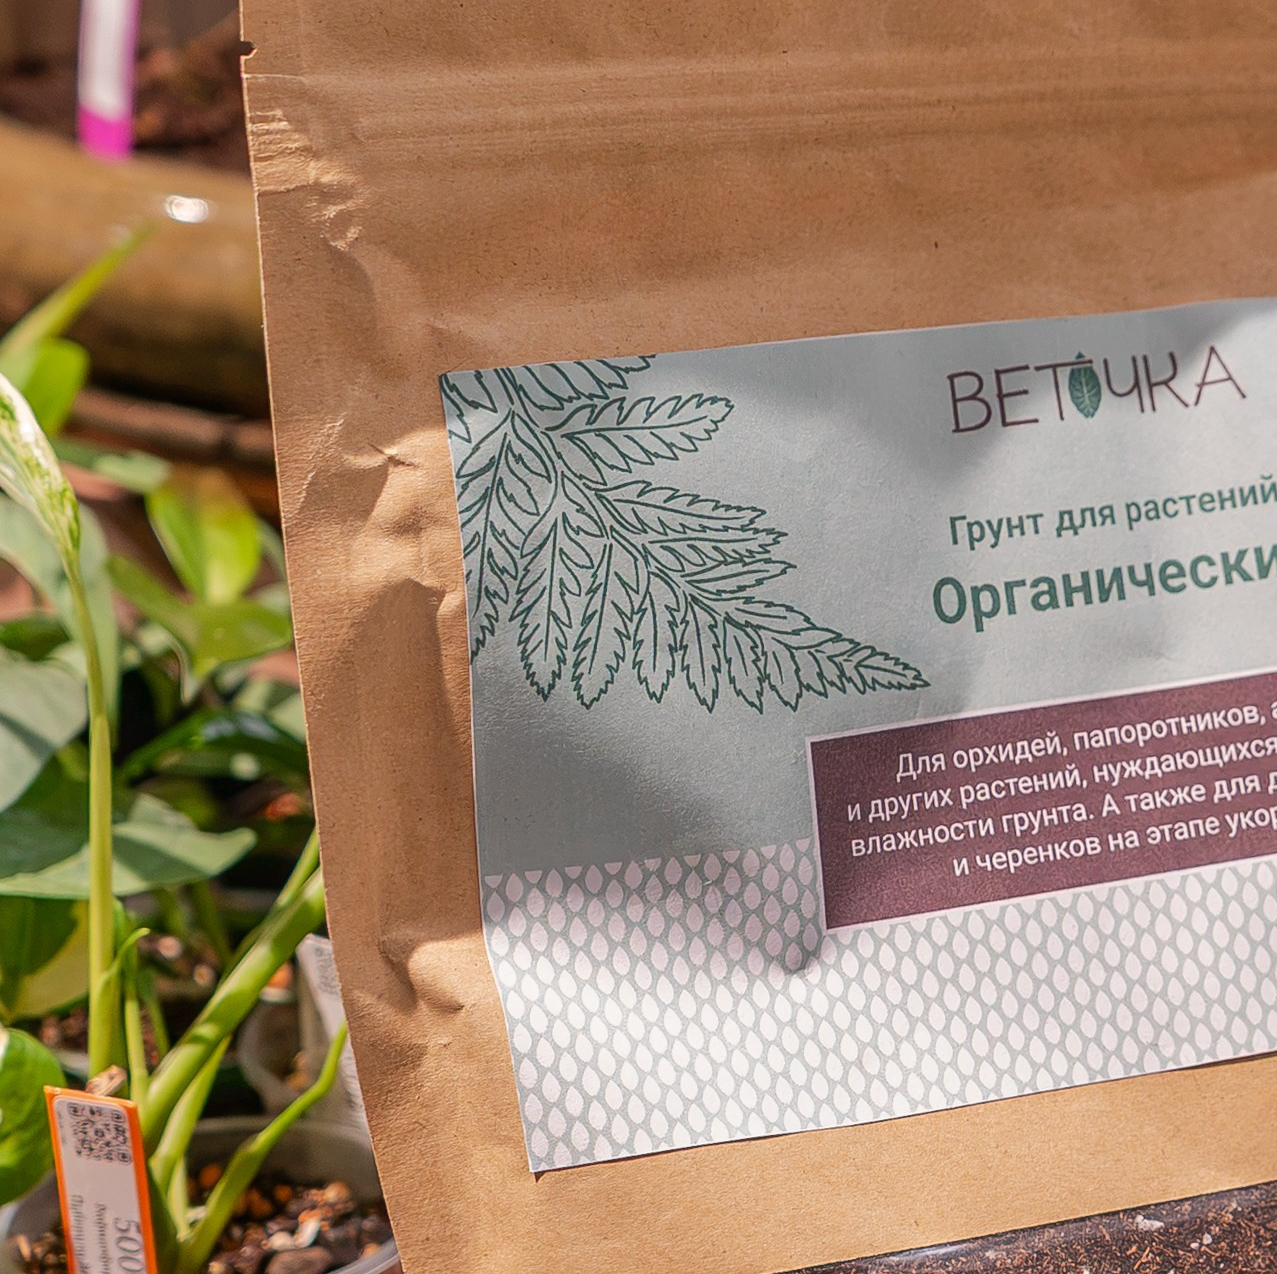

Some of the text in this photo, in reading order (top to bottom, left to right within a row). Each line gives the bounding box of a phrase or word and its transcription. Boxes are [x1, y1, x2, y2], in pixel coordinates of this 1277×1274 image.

[950, 513, 1044, 551] Грунт
[1056, 505, 1116, 538] для
[896, 753, 946, 782] Для
[953, 731, 1068, 772] орхидей,
[1074, 704, 1266, 750] папоротников,
[847, 802, 860, 822] и
[868, 790, 954, 823] других
[960, 765, 1088, 809] растений,
[851, 817, 995, 857] влажности
[1001, 800, 1094, 838] грунта.
[1101, 794, 1121, 817] А
[1125, 783, 1207, 813] также
[1213, 777, 1261, 803] для
[953, 856, 969, 876] и
[976, 836, 1101, 876] черенков
[1108, 830, 1140, 851] на
[1147, 817, 1221, 847] этапе
